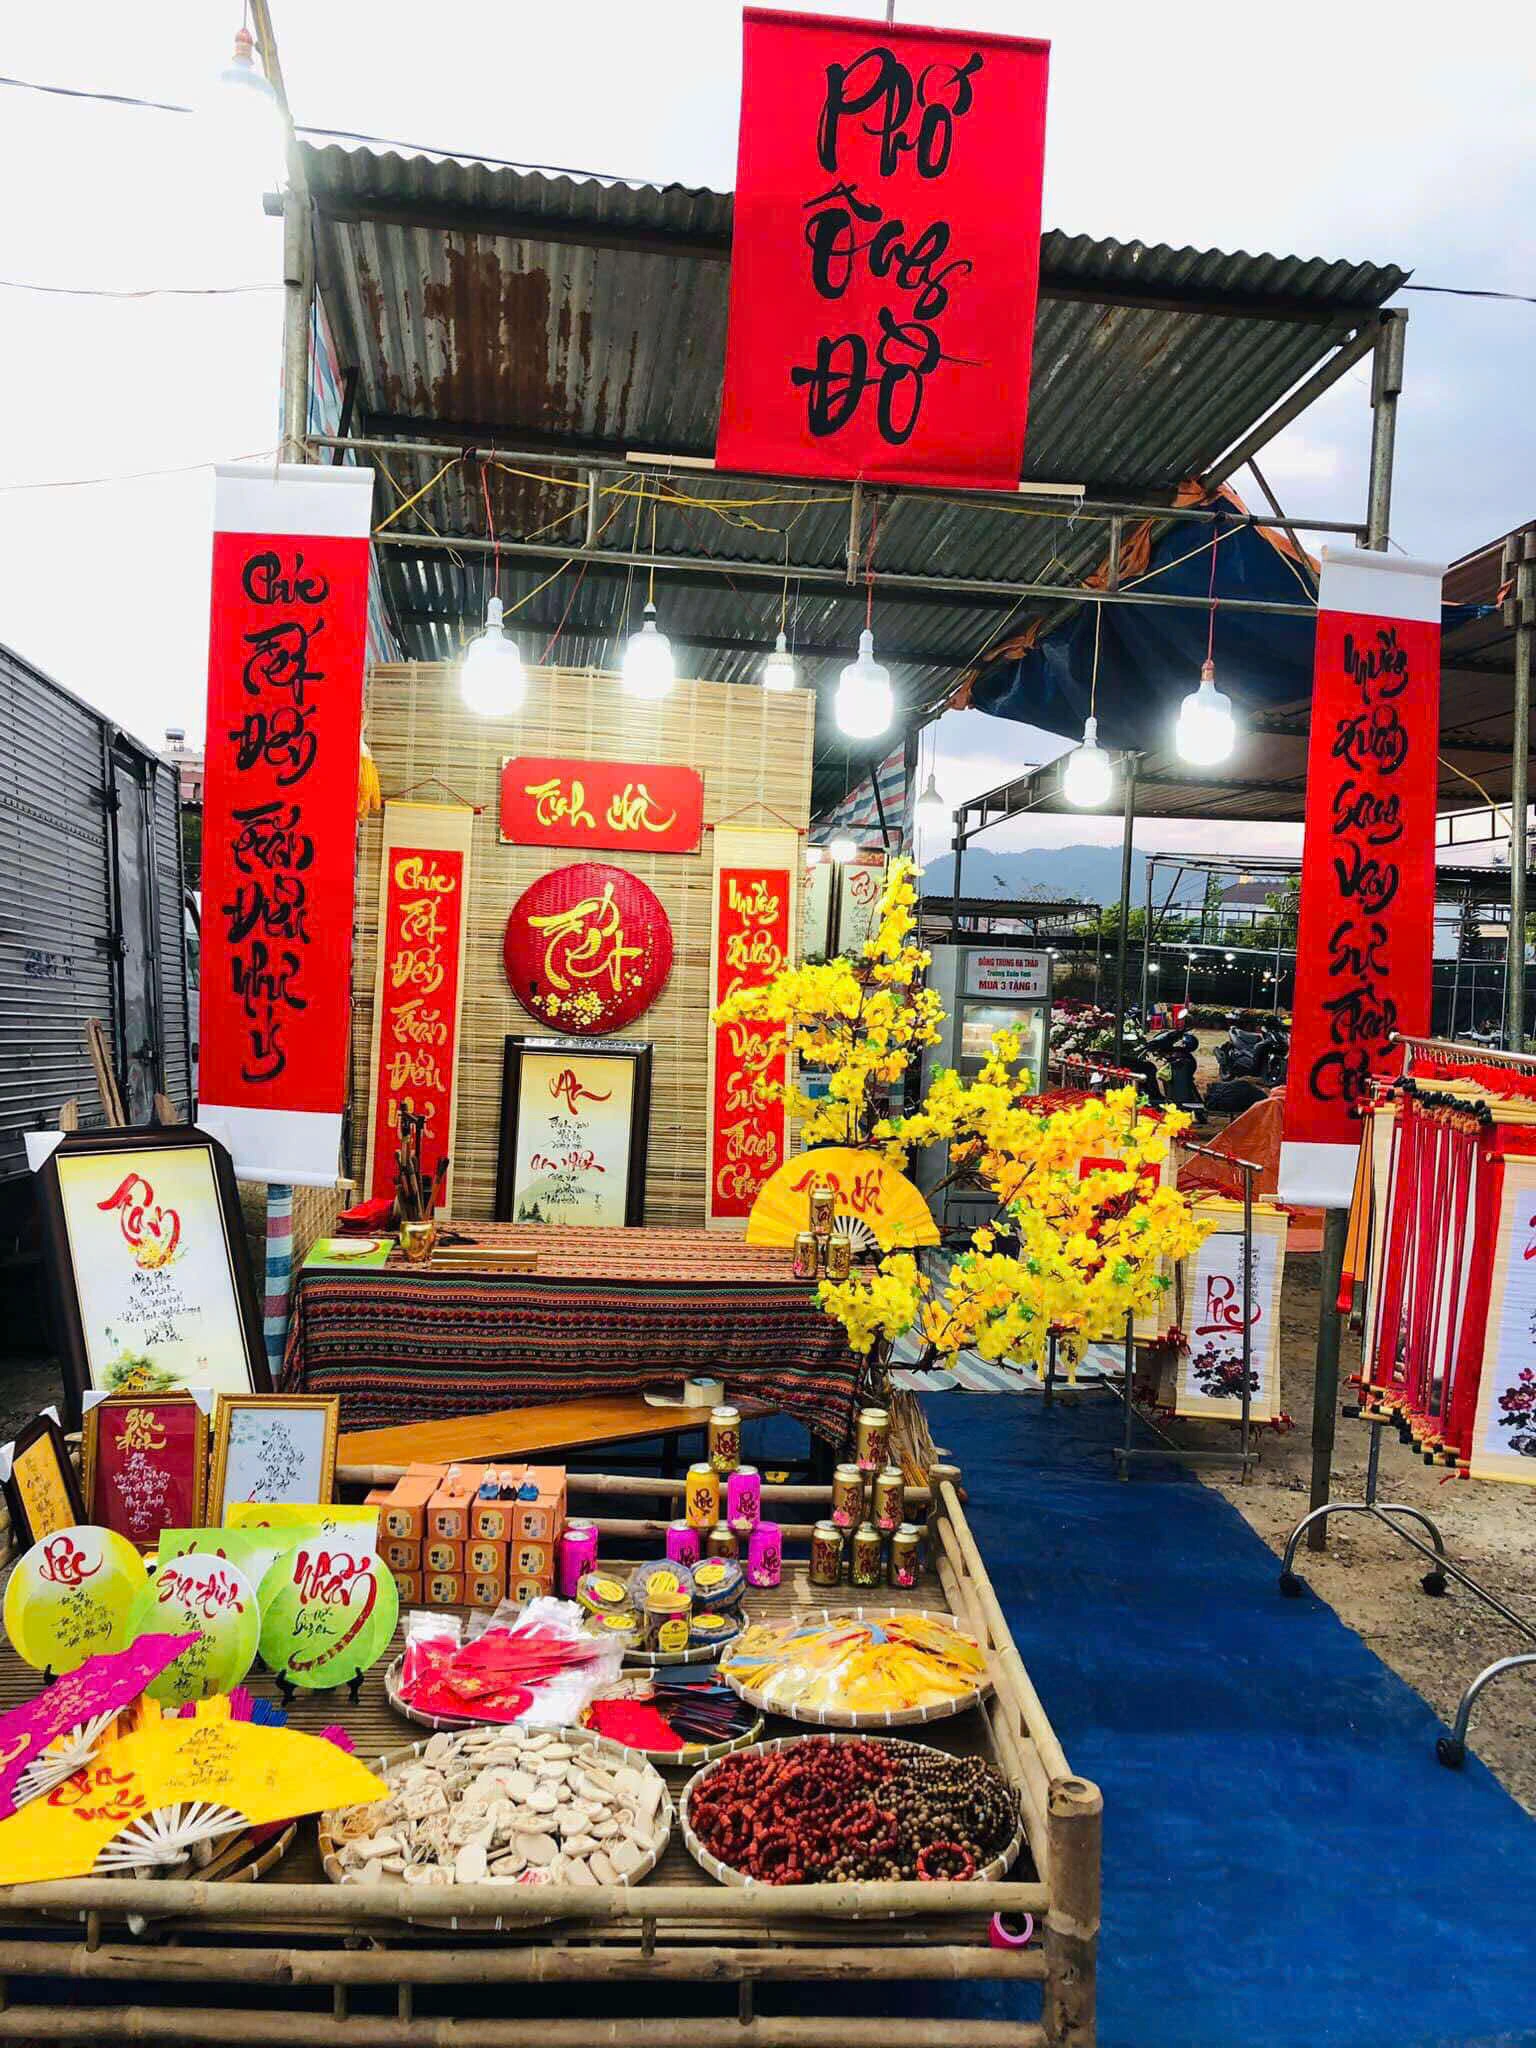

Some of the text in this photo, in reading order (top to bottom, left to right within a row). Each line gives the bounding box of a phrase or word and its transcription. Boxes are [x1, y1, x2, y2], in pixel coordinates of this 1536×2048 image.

[803, 181, 972, 320] Ông
[792, 307, 983, 445] Đồ
[394, 856, 456, 893] Chúc
[399, 896, 448, 944] Tết
[728, 879, 779, 927] Mừng
[527, 881, 643, 992] Tết
[726, 929, 782, 976] Xuân
[979, 980, 998, 990] MUA
[1001, 981, 1006, 990] 3
